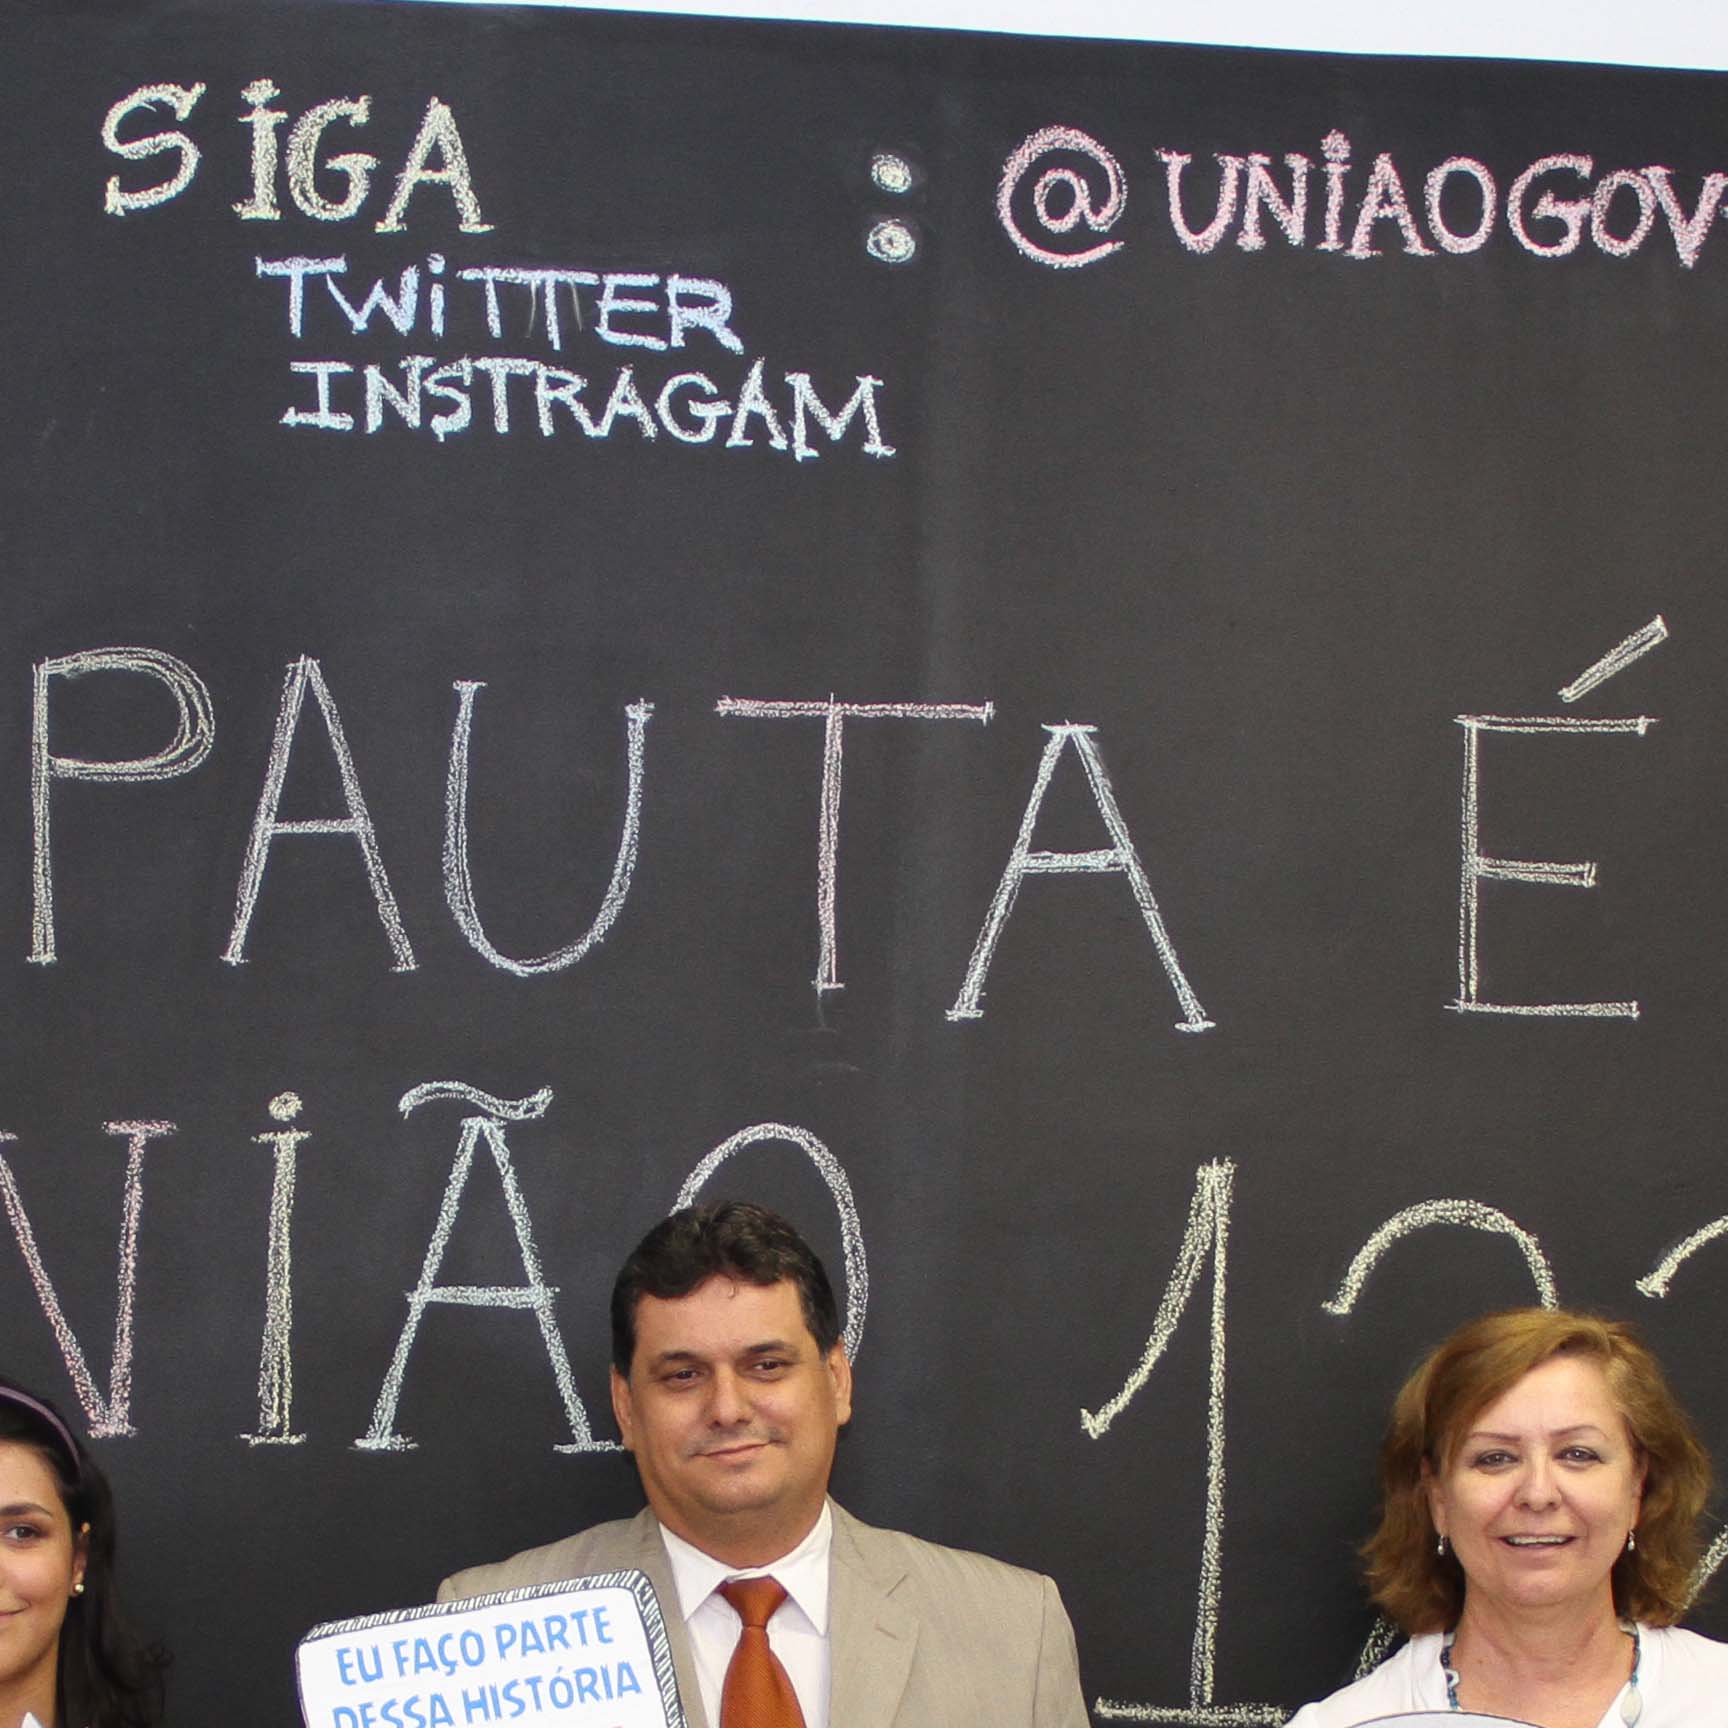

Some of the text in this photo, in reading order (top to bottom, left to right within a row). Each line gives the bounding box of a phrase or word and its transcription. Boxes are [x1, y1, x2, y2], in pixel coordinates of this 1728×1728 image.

[279, 356, 897, 461] INSTRAGAM
[26, 646, 1216, 1033] PAUTA
[1444, 613, 1669, 1021] É
[336, 1605, 615, 1686] EU FAÇO PARTE
[462, 1660, 643, 1726] HISTÓRIA
